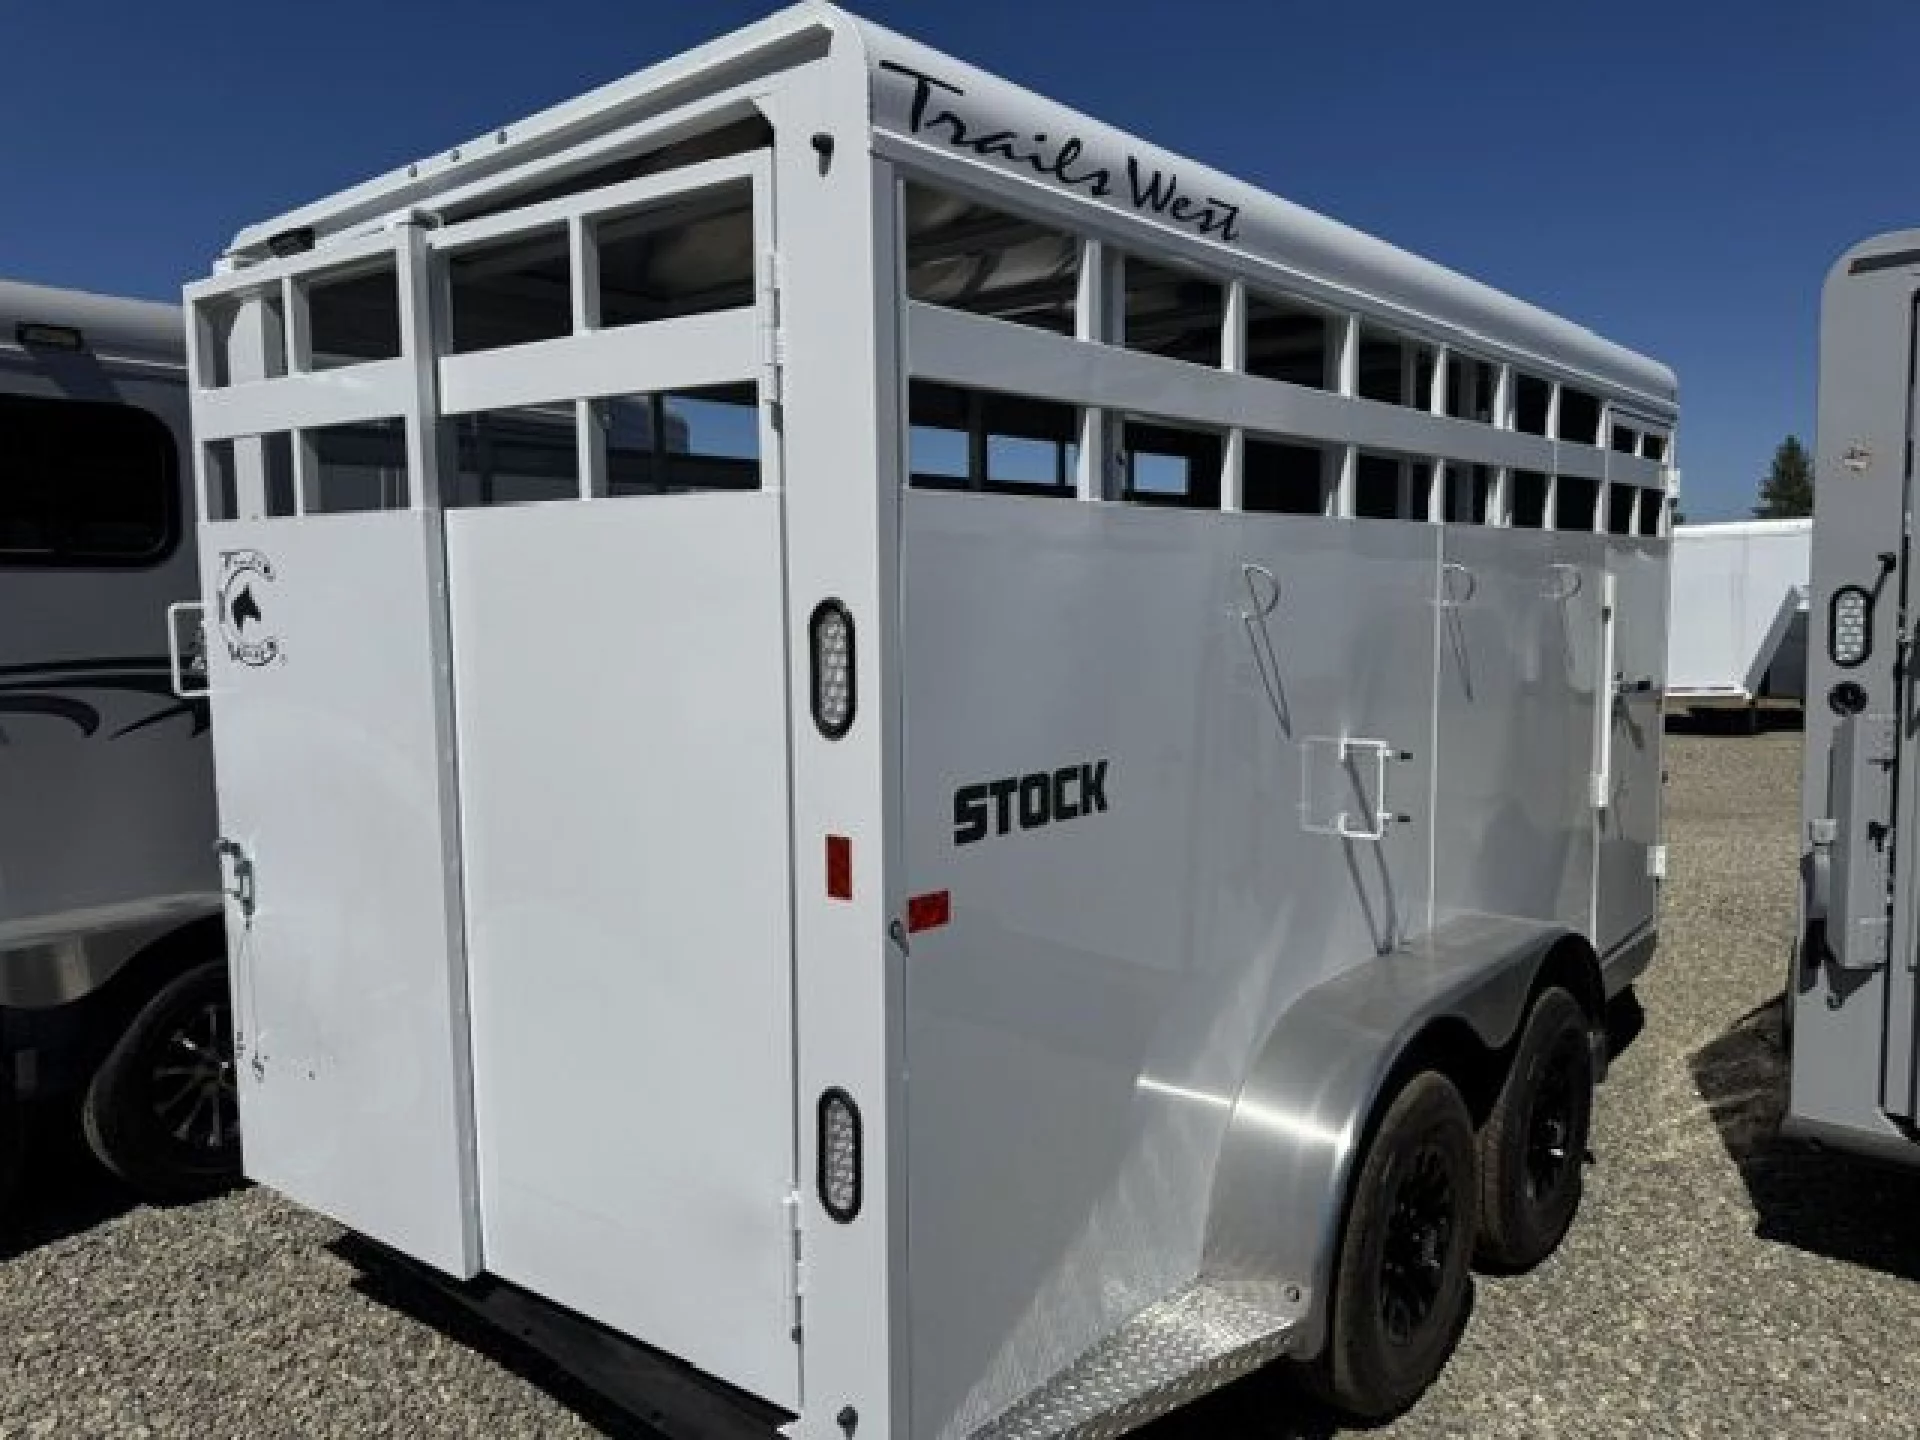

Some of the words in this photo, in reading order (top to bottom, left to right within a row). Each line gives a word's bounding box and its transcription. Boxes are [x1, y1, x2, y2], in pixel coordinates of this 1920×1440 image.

[879, 59, 1110, 196] Trails
[1127, 155, 1239, 241] West
[953, 759, 1108, 846] STOCK
